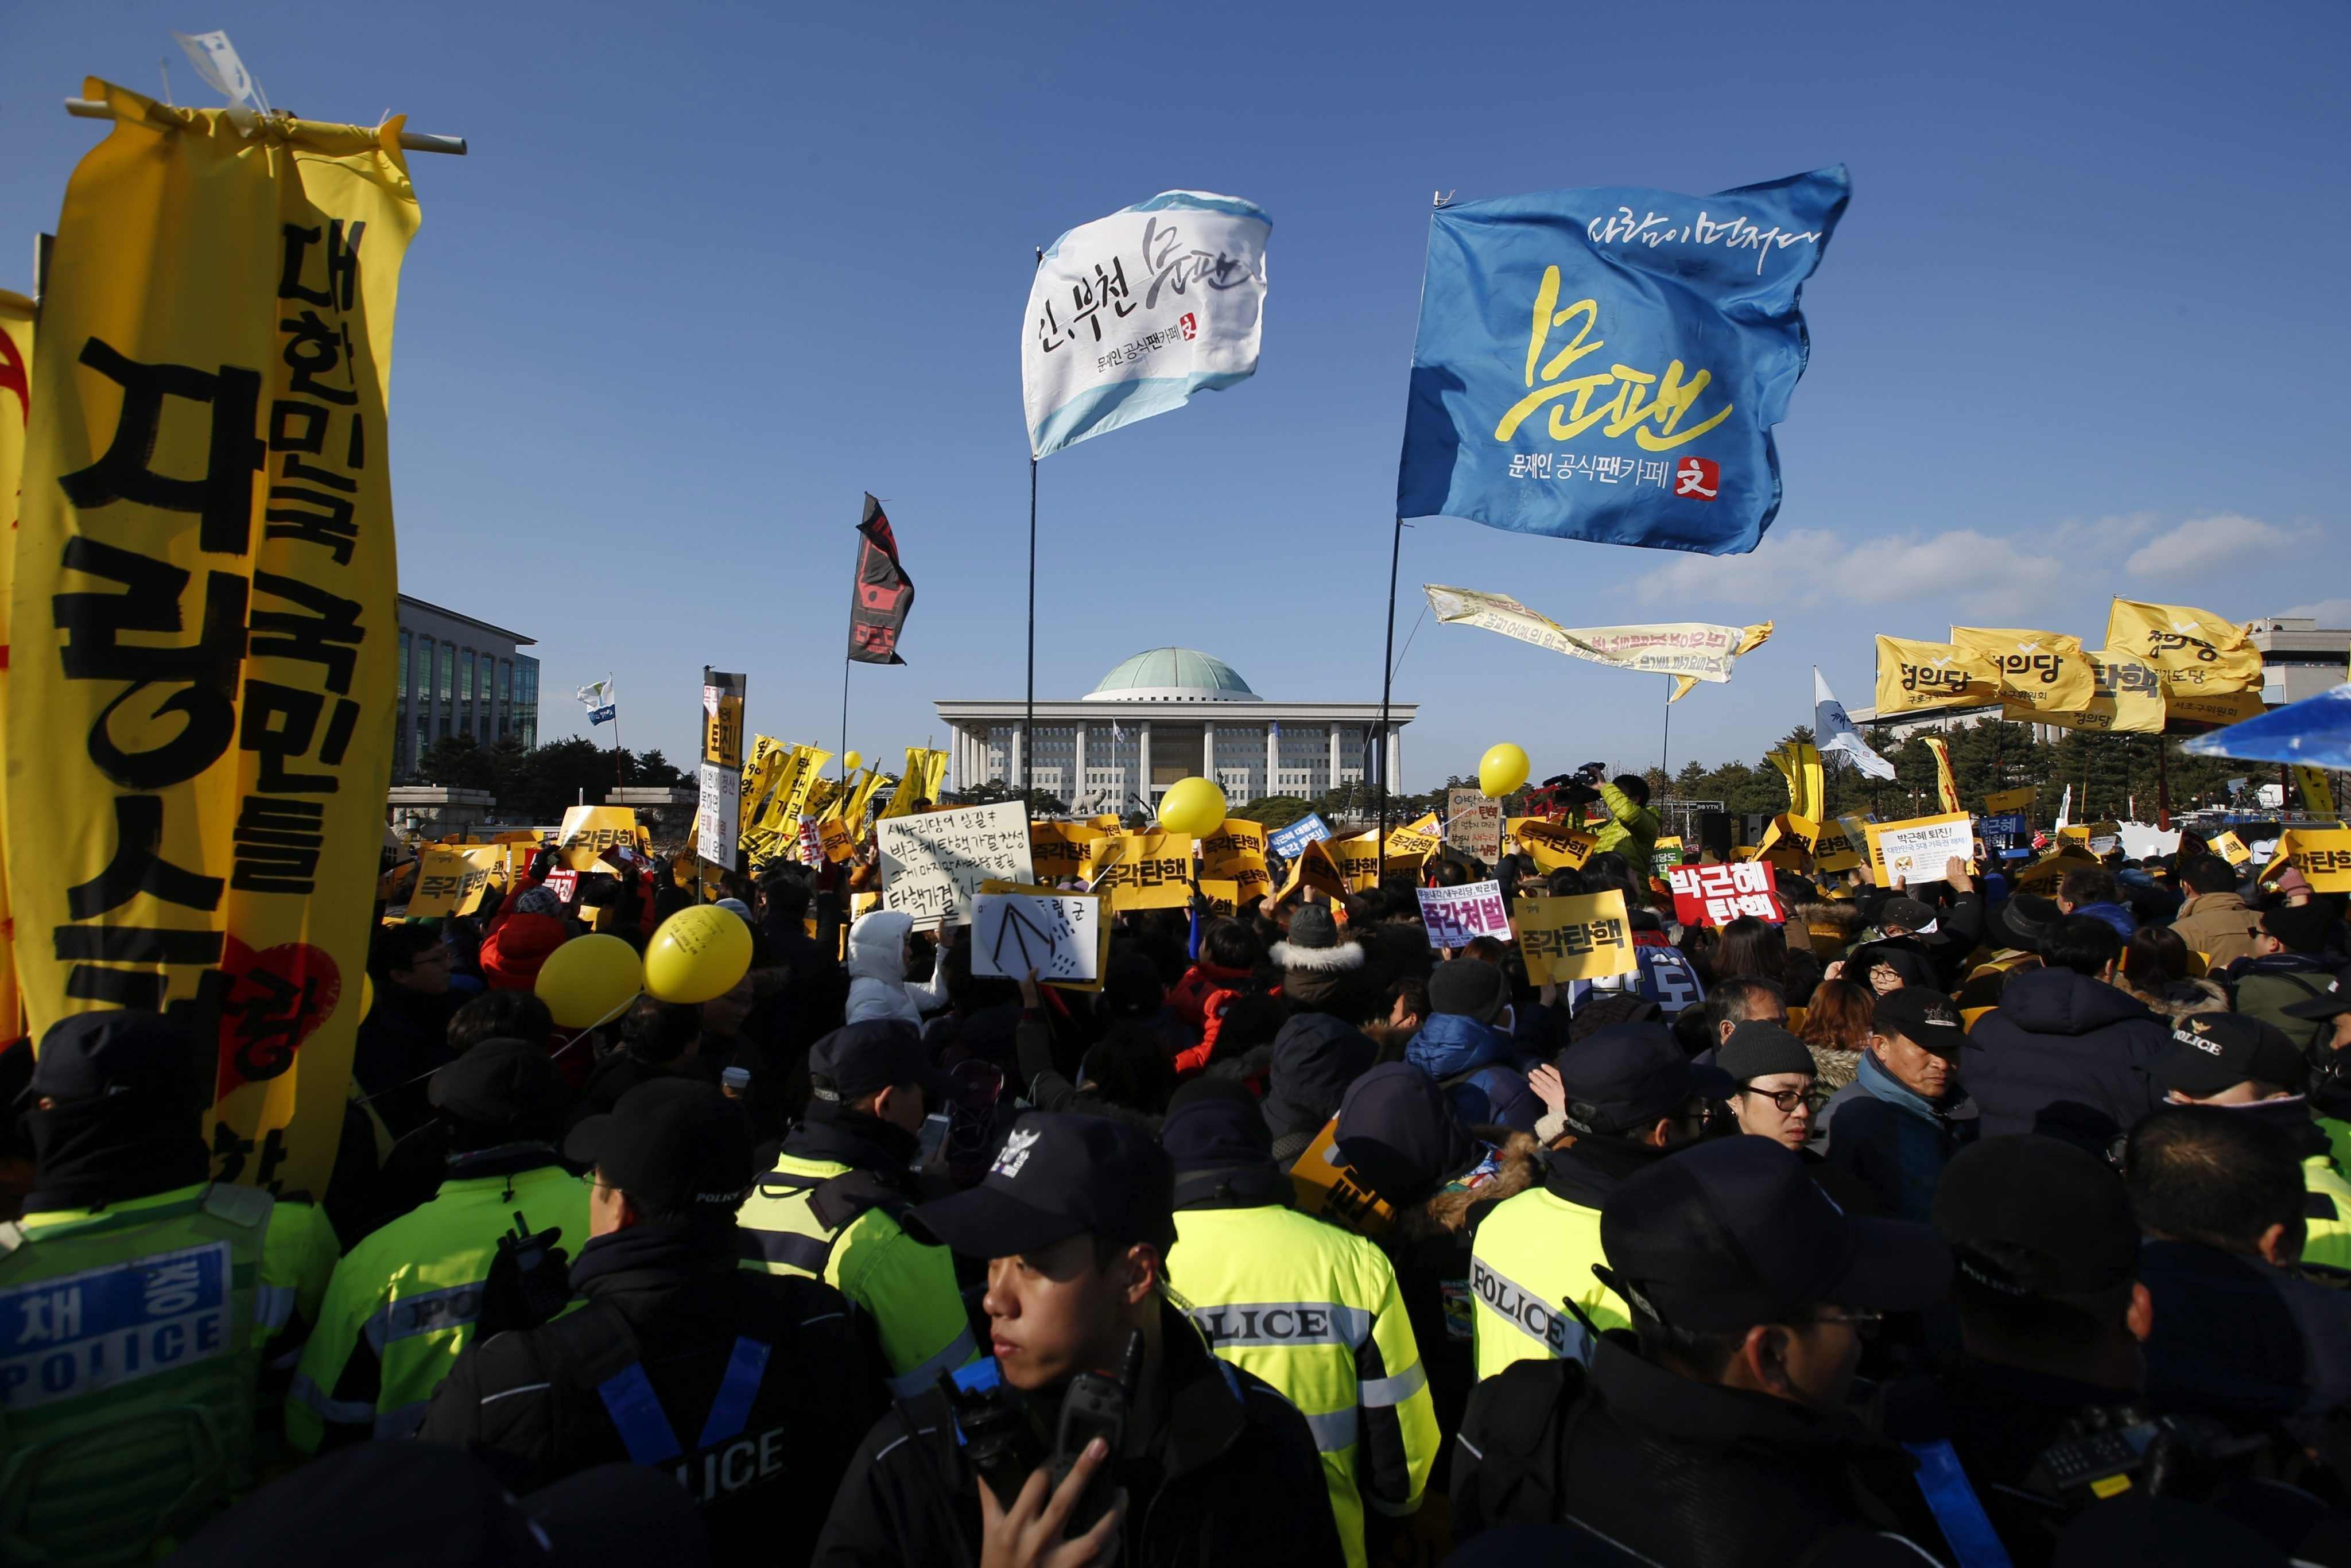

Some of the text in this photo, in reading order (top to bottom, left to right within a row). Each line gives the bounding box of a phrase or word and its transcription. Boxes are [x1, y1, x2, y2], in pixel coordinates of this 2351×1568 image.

[1097, 347, 1123, 373] 문재인
[1508, 452, 1551, 479] 문재인
[2074, 711, 2112, 728] 정의당
[1897, 831, 1927, 844] 박근혜
[1927, 826, 1953, 839] 퇴진!
[1981, 817, 2017, 835] 박근혜
[890, 838, 936, 863] 박근혜
[937, 834, 971, 856] 탄핵
[999, 830, 1025, 849] 찬성
[1205, 833, 1260, 854] 즉각탄핵
[1389, 833, 1434, 856] 즉각탄핵
[1520, 826, 1590, 861] 즉각탄핵
[1887, 844, 1915, 855] 대한민국
[421, 867, 491, 899] 즉각탄핵
[920, 861, 955, 878] 마지막
[1097, 857, 1187, 888] 즉각탄핵
[1670, 862, 1770, 899] 박근혜
[1706, 894, 1778, 926] 탄핵
[1522, 917, 1625, 961] 즉각탄핵
[1472, 1262, 1566, 1353] POLICE
[0, 1313, 220, 1403] POLICE
